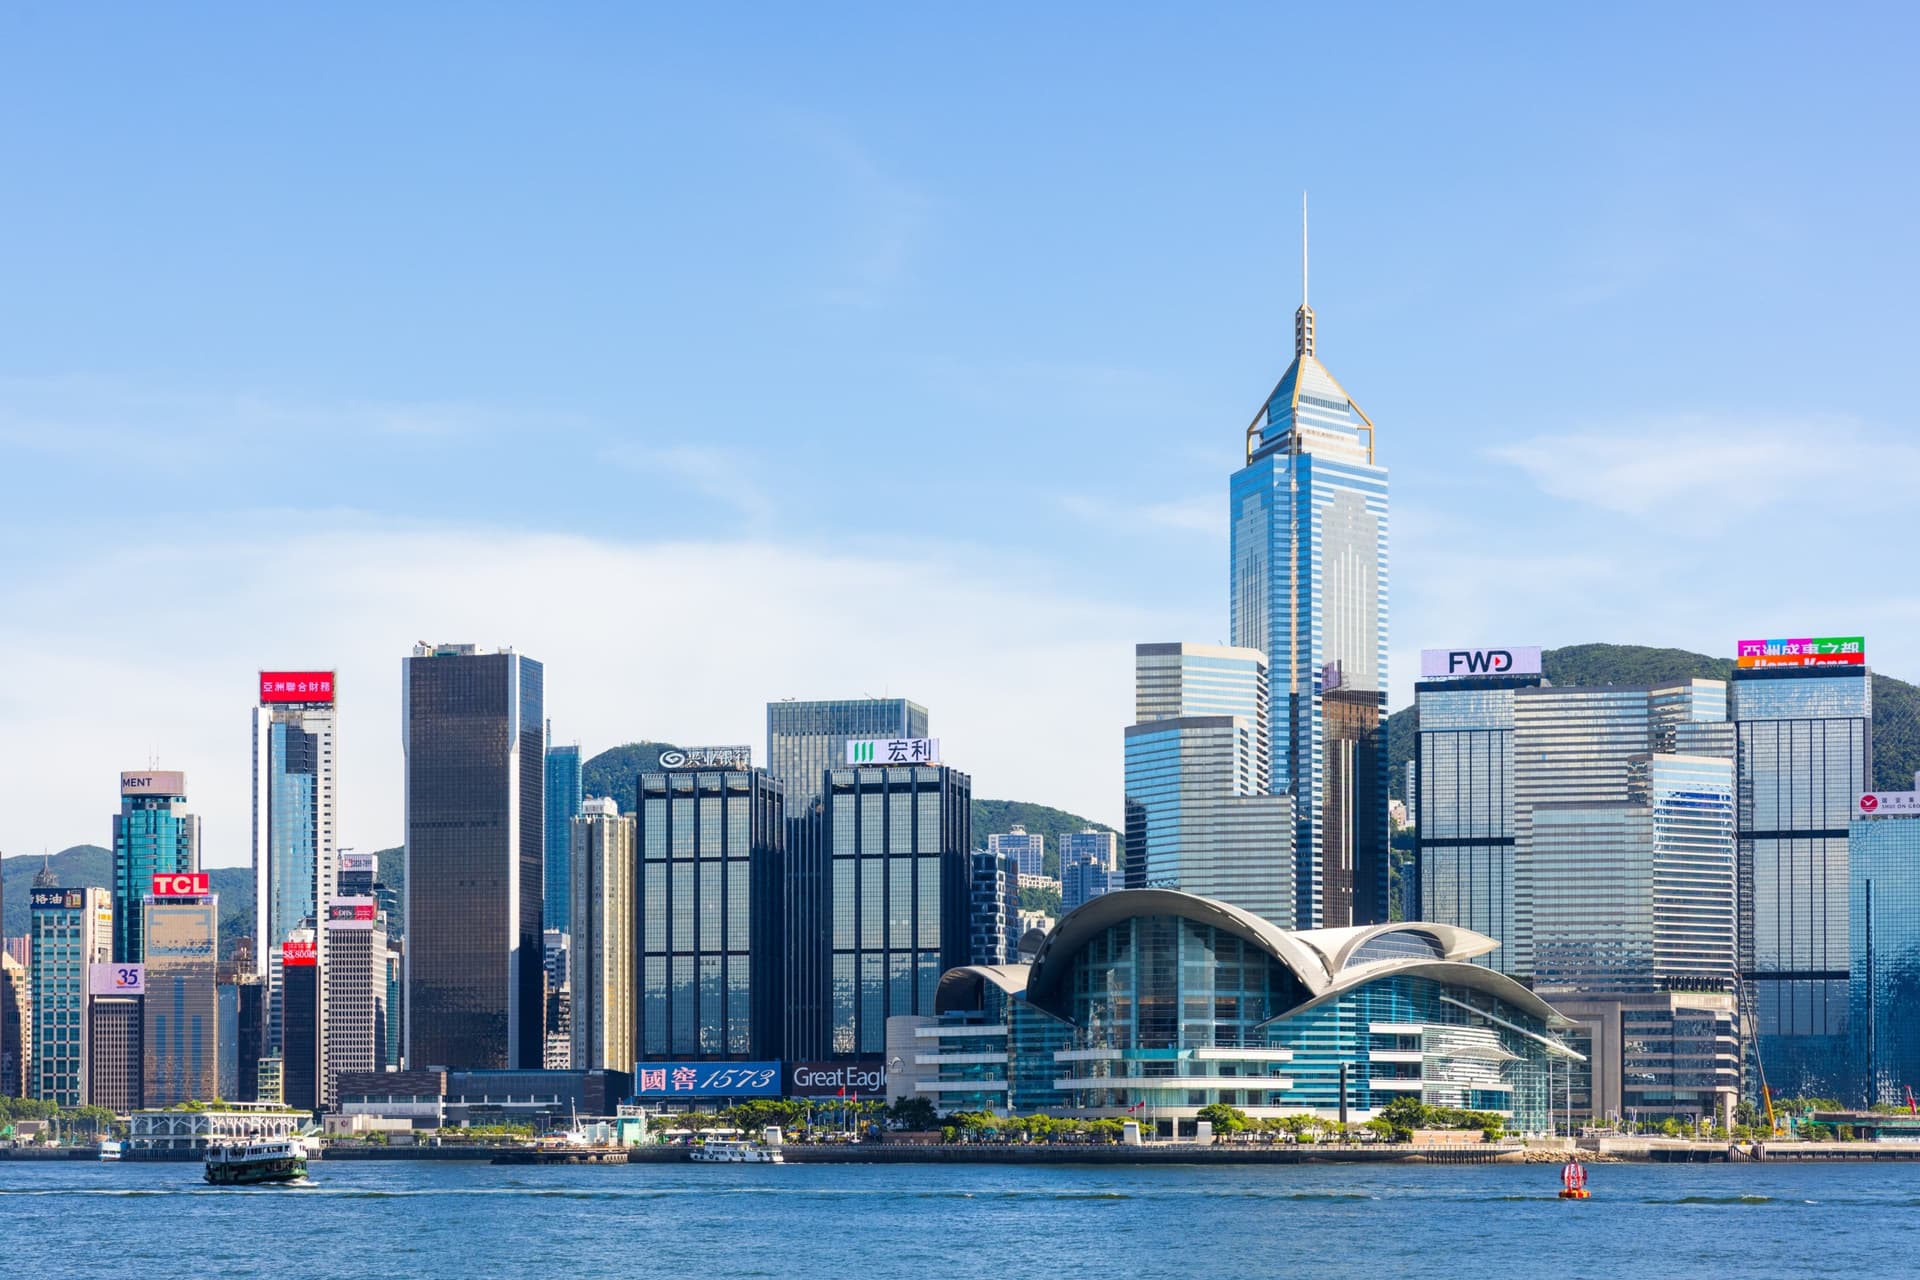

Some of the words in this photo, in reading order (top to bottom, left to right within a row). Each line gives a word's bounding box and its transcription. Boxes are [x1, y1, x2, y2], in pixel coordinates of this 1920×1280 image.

[1449, 650, 1513, 673] FWD
[263, 681, 331, 692] 亞洲聯合財務
[888, 739, 932, 761] 宏利
[122, 777, 152, 787] MENT
[154, 876, 208, 894] TCL
[116, 969, 139, 985] 35
[640, 1066, 698, 1092] 國窖
[700, 1069, 776, 1089] 1573
[793, 1067, 844, 1086] Great
[846, 1065, 887, 1091] Eagl
